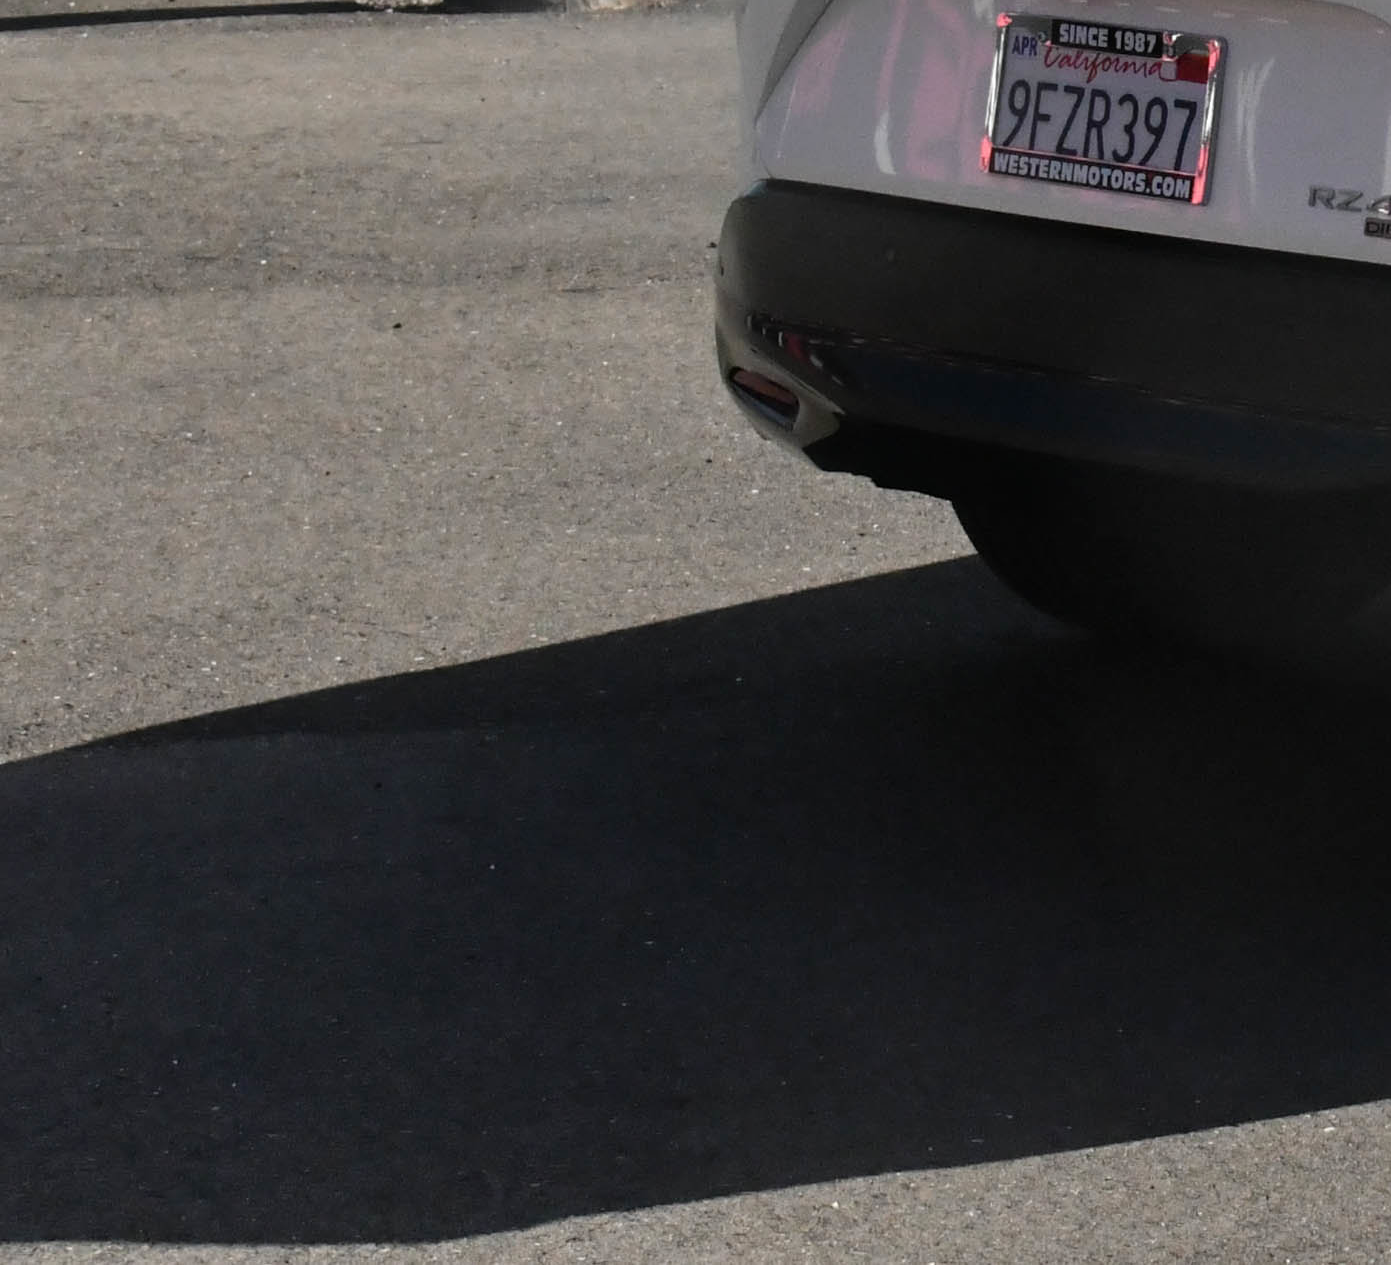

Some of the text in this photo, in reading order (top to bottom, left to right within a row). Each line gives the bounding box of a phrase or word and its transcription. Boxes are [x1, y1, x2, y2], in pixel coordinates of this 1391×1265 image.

[1011, 35, 1039, 58] APR
[1058, 23, 1158, 53] SINCE 1987
[1042, 43, 1172, 84] California
[1001, 78, 1199, 172] 9FZR397
[993, 151, 1191, 200] WESTERNMOTORS.COM
[1307, 185, 1364, 213] RZ
